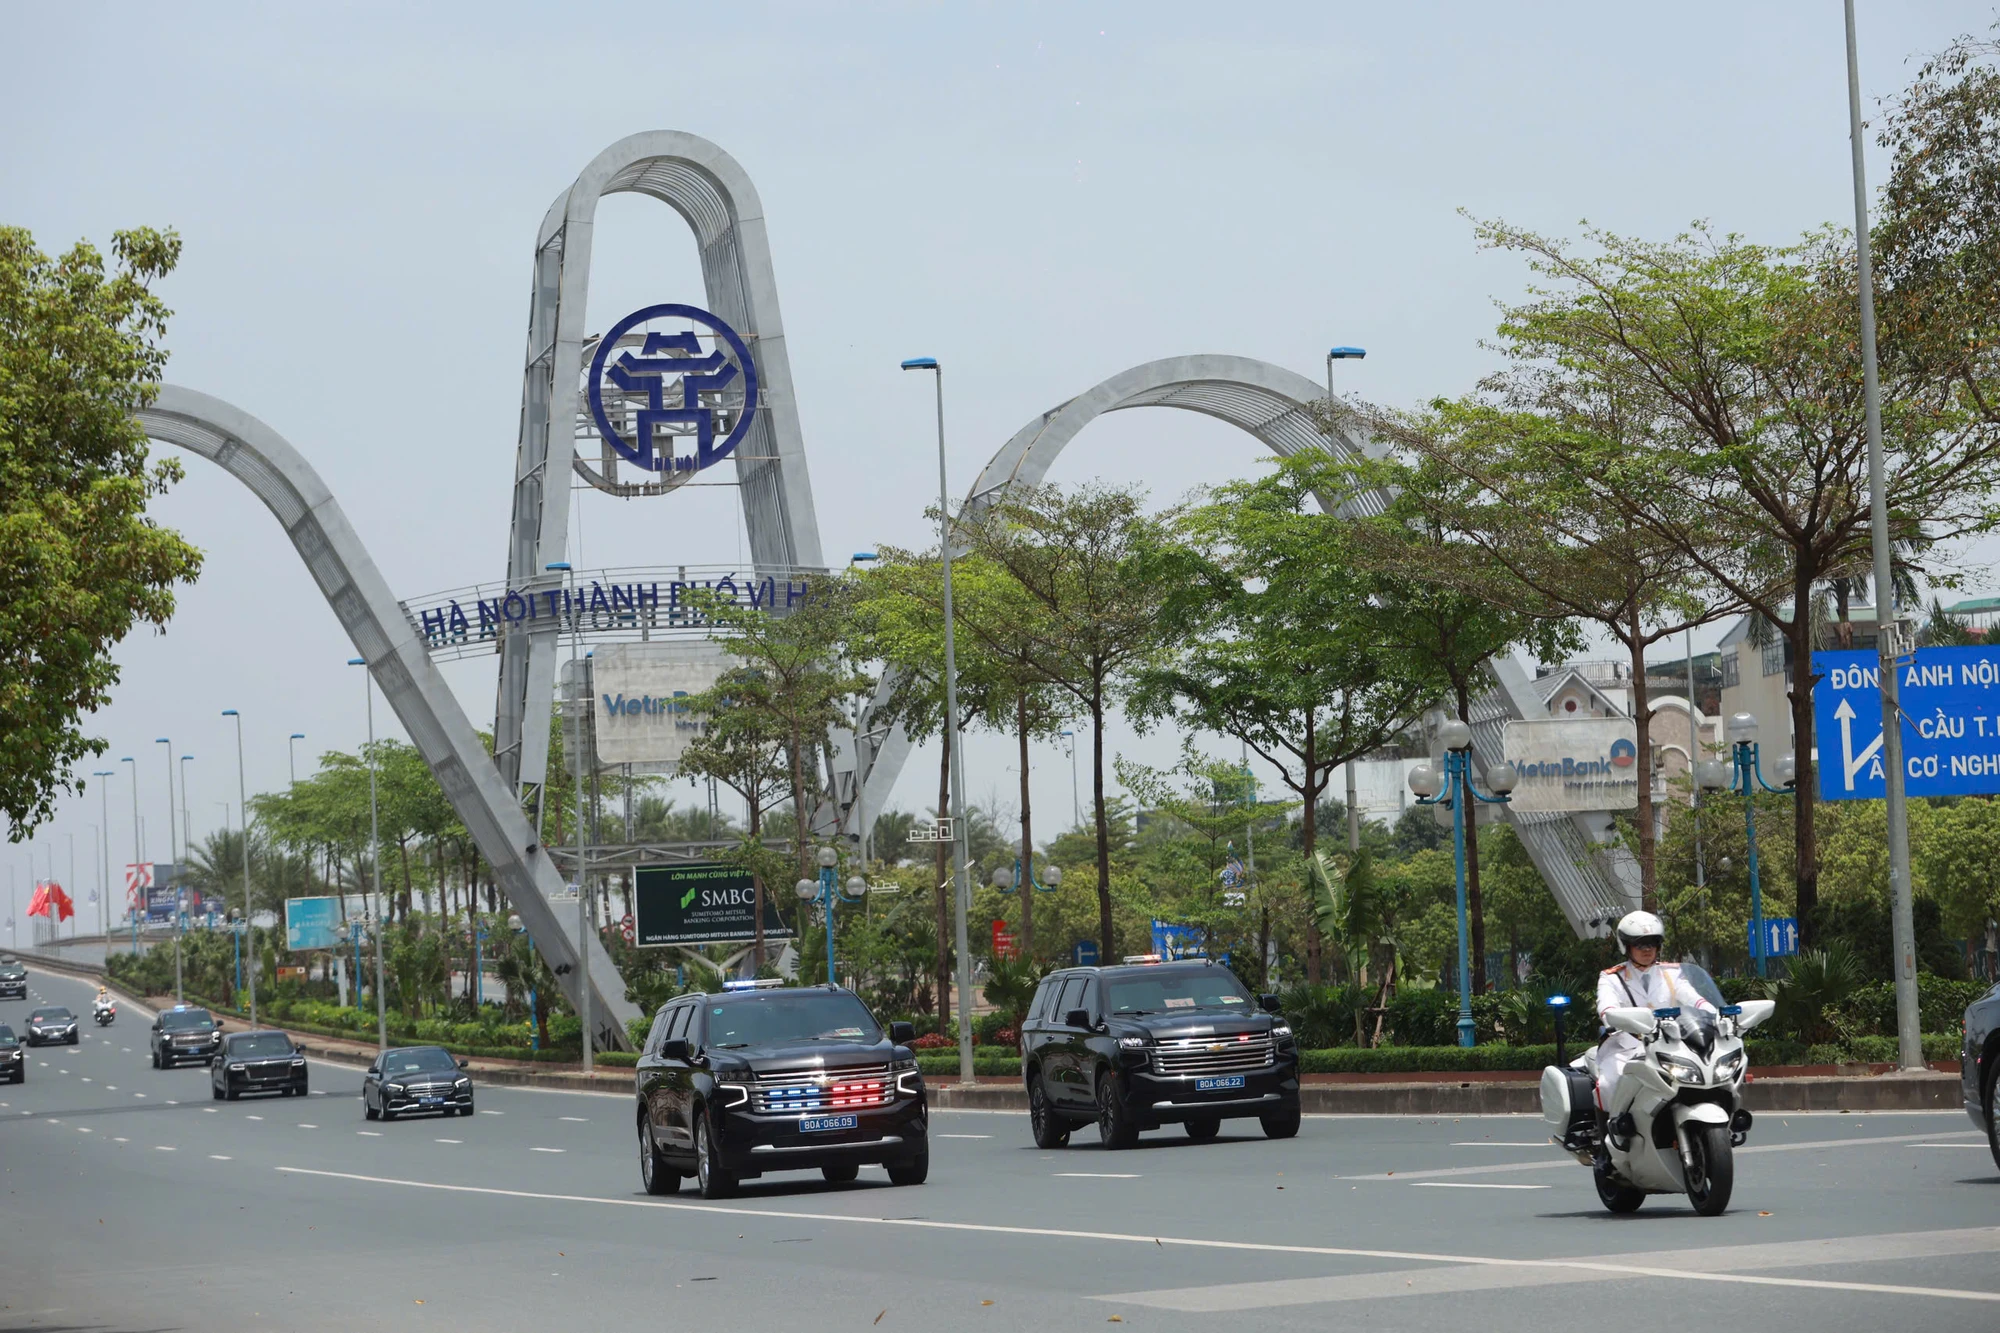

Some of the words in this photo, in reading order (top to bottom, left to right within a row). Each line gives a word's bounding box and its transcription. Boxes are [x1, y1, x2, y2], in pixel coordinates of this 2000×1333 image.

[421, 599, 470, 639] HÀ
[478, 590, 536, 628] NỘI
[542, 581, 658, 617] THÀNH
[745, 576, 775, 609] VÌ
[1831, 663, 1879, 689] ĐÔN
[1904, 665, 1953, 687] ANH
[1962, 658, 1999, 689] NỘI
[1919, 707, 1965, 739] CẦU
[1508, 756, 1612, 778] VietinBank
[1869, 754, 1886, 780] Â
[701, 888, 755, 907] SMBC
[1200, 1077, 1241, 1088] 80A-066.22
[804, 1117, 853, 1130] 80A-066.09
